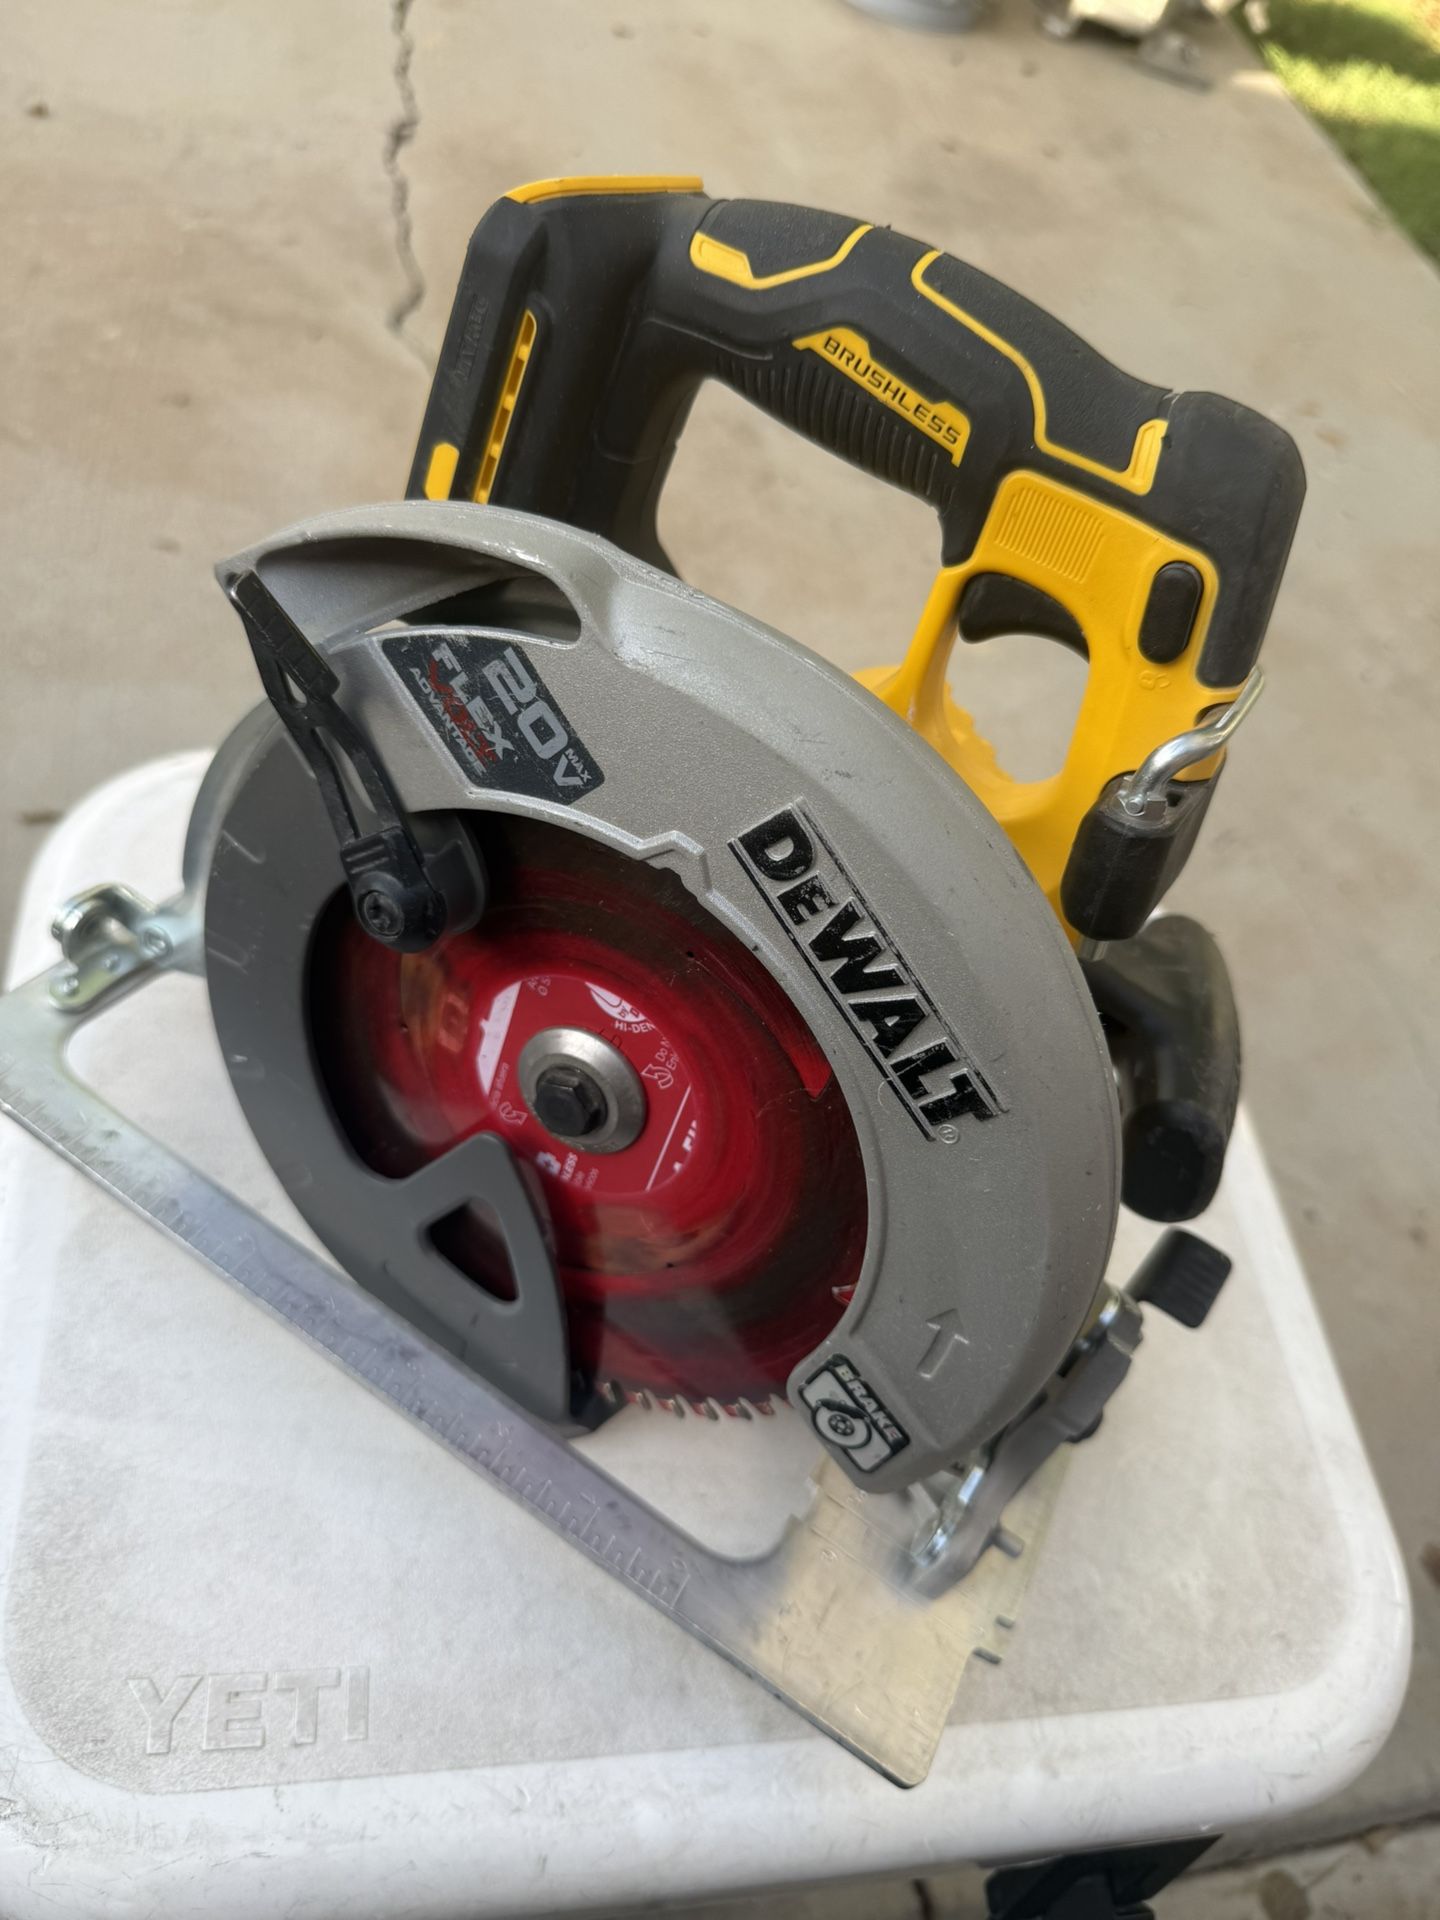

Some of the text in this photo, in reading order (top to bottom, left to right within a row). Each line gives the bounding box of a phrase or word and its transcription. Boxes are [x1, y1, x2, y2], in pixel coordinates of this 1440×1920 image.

[824, 336, 961, 445] BRUSHLESS
[432, 643, 515, 760] FLEX
[482, 646, 592, 787] 20V MAX
[738, 802, 998, 1123] DEWALT
[834, 1363, 903, 1443] BRAKE
[126, 1664, 371, 1756] YETI
